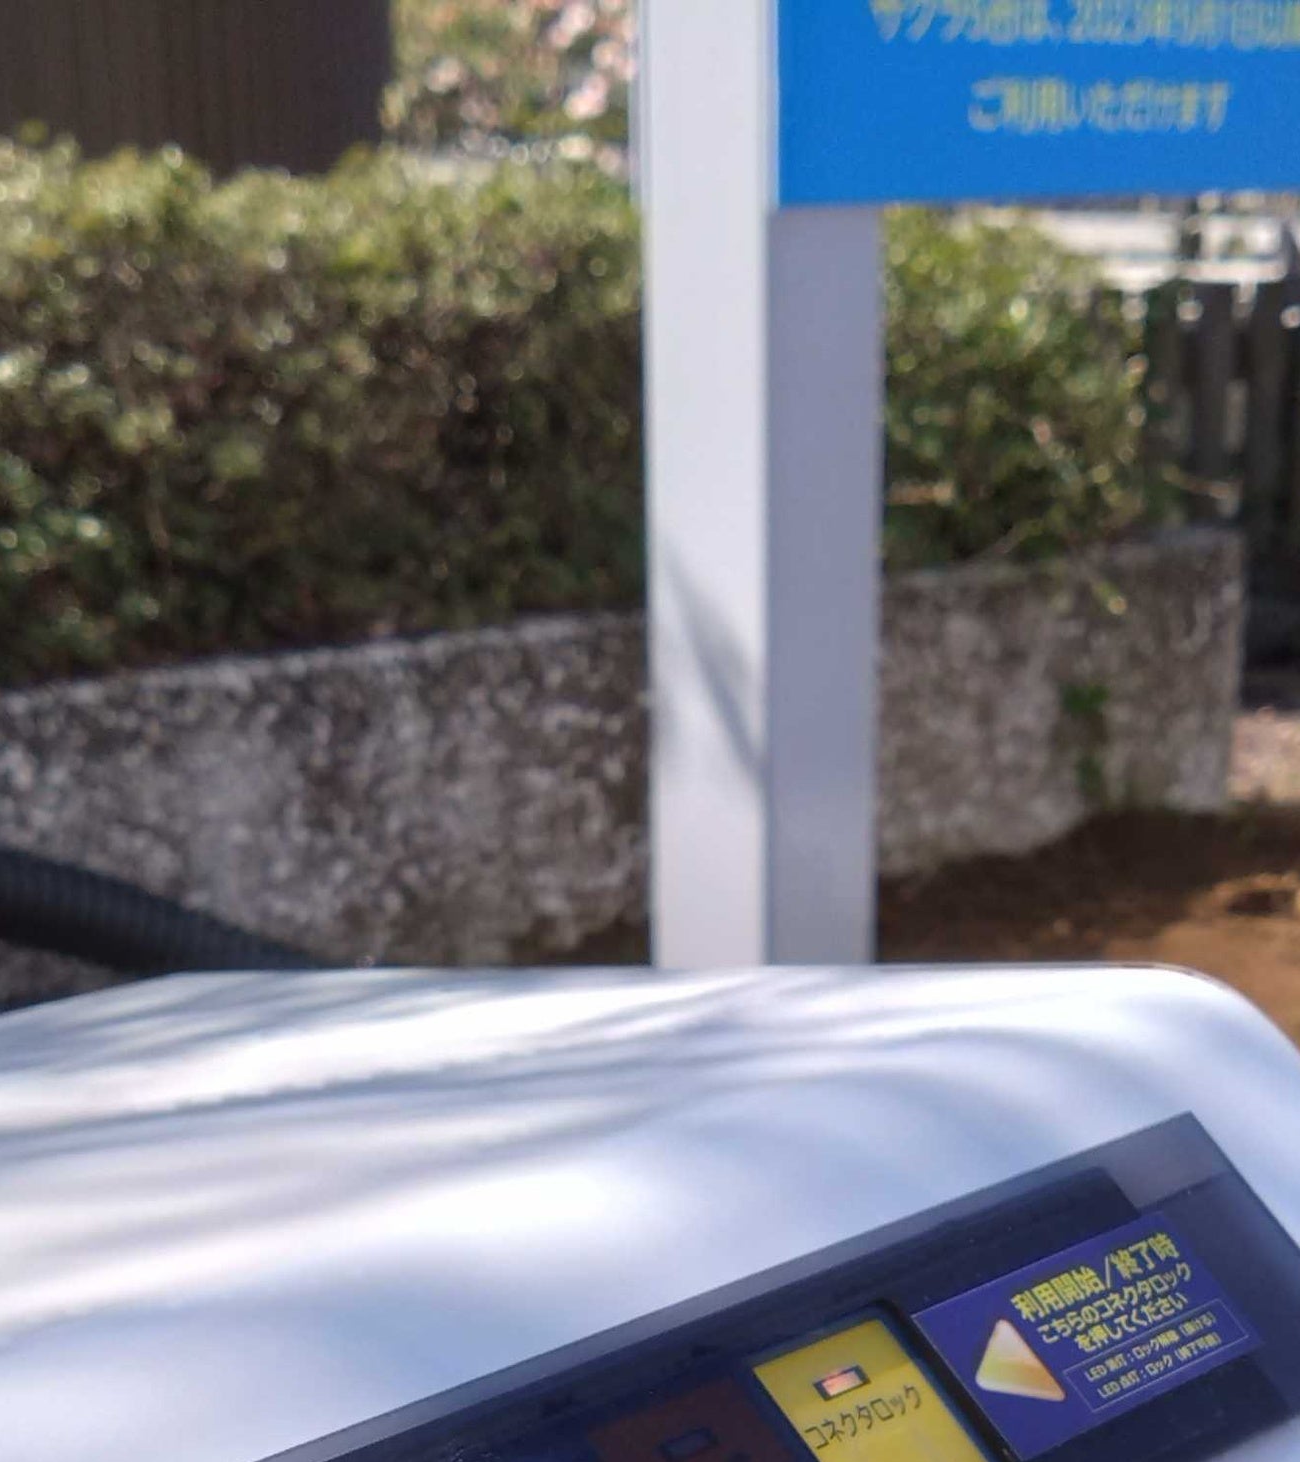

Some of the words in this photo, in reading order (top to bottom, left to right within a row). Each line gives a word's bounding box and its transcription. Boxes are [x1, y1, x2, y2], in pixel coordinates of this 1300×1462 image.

[1037, 1262, 1192, 1344] こちらのコネクタロック
[1075, 1292, 1189, 1352] を押してください
[803, 1384, 922, 1450] コネクタロック
